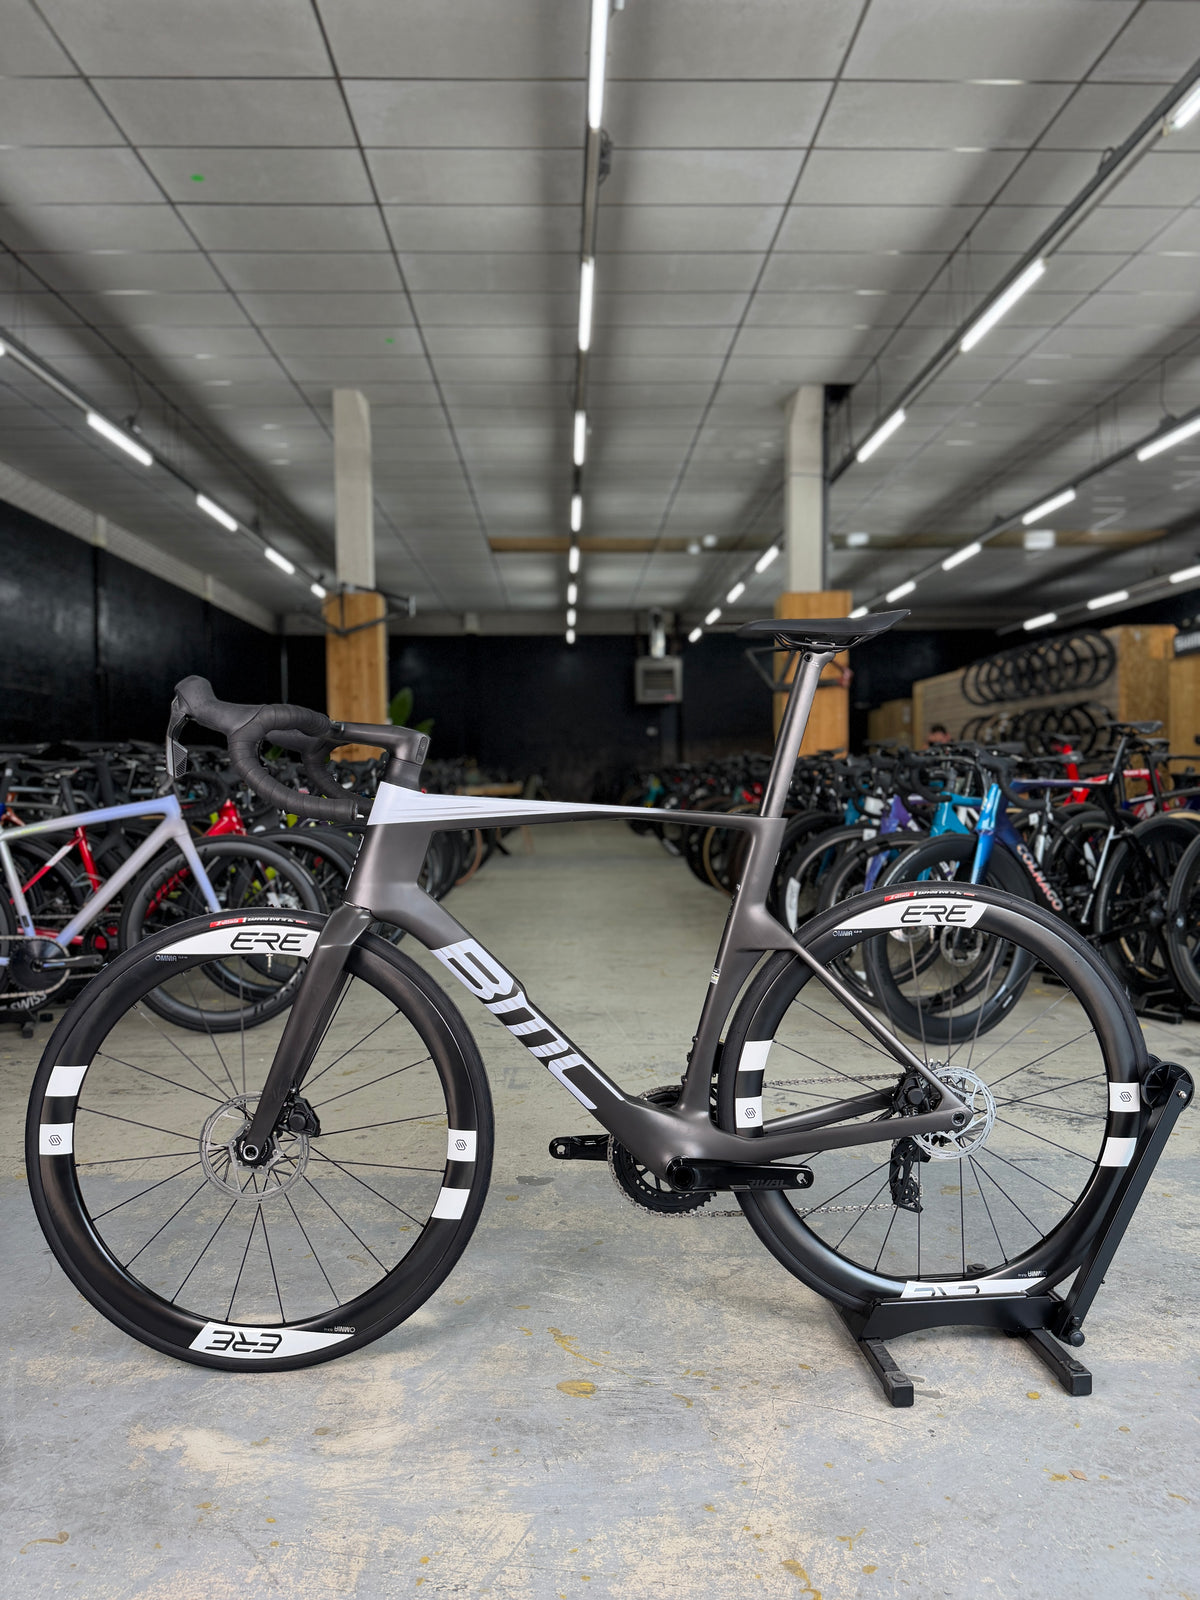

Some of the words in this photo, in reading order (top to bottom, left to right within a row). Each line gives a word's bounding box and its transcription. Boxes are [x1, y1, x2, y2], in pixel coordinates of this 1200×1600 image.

[1016, 843, 1063, 911] COLNAGO
[900, 904, 973, 924] ERE
[230, 932, 309, 951] ERE
[154, 954, 177, 962] OMNIA
[430, 938, 625, 1110] BMC
[205, 1330, 283, 1354] ERE
